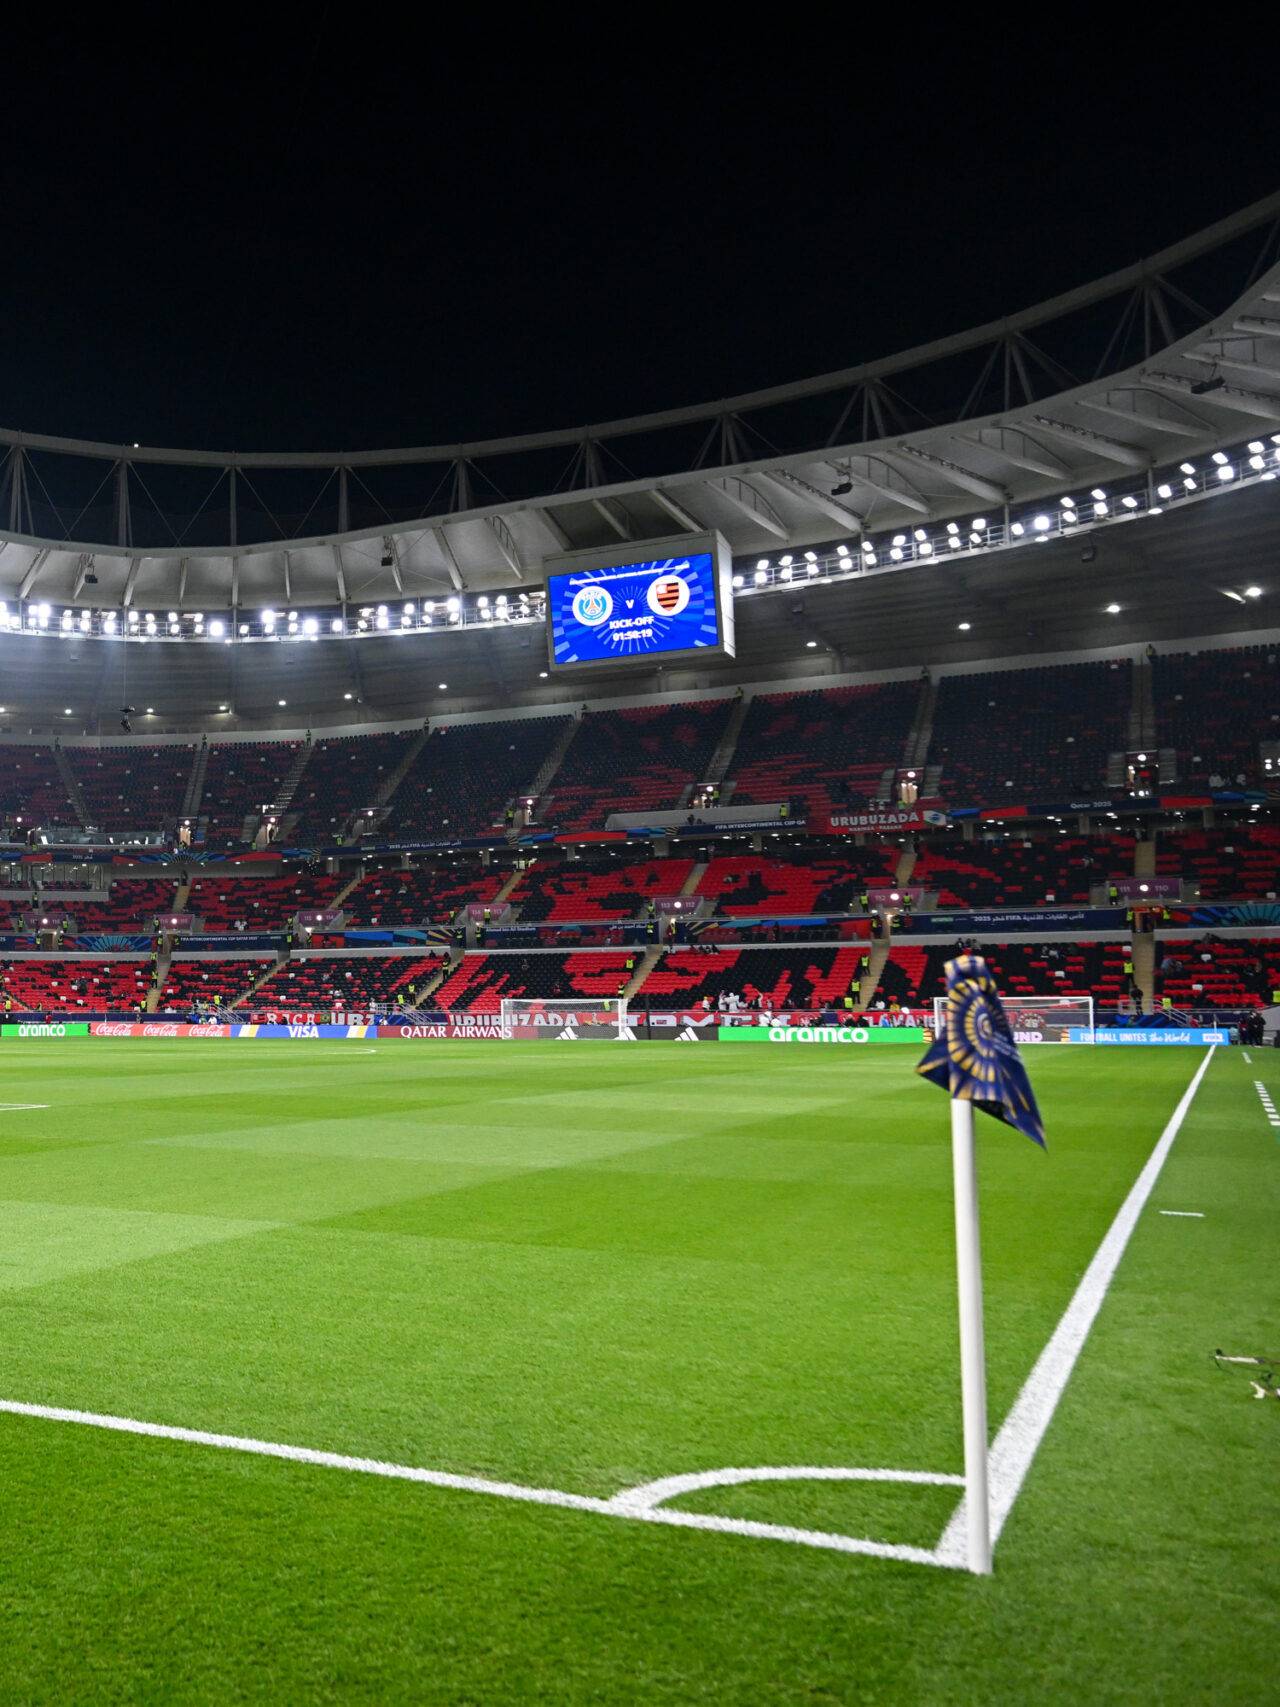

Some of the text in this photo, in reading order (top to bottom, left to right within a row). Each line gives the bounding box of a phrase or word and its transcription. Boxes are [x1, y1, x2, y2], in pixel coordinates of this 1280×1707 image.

[609, 615, 654, 629] KICK-OFF
[830, 812, 920, 827] URUBUZADA
[18, 1024, 66, 1037] aramco
[285, 1026, 319, 1038] VISA
[400, 1026, 447, 1039] QATAR
[768, 1027, 869, 1043] aramco
[1120, 1033, 1147, 1042] UNITES
[1149, 1032, 1164, 1042] the
[1164, 1032, 1190, 1043] World
